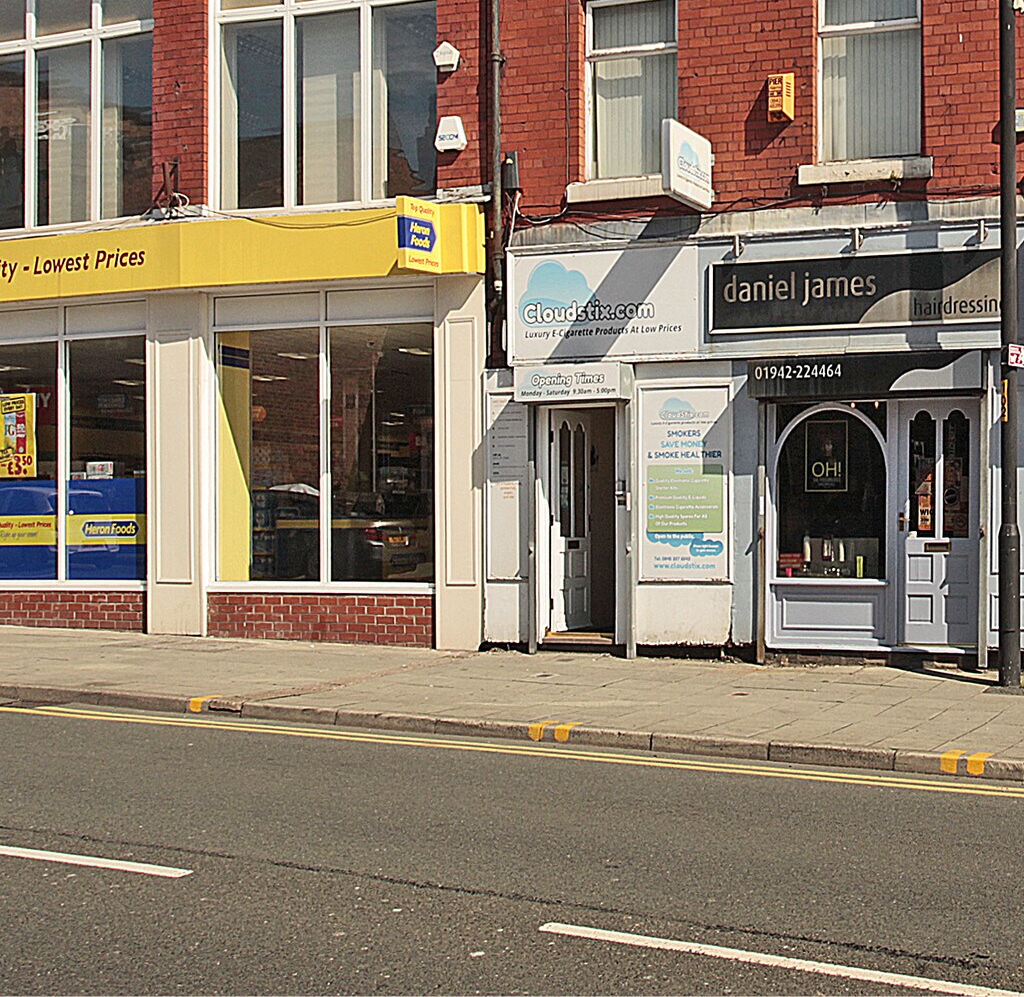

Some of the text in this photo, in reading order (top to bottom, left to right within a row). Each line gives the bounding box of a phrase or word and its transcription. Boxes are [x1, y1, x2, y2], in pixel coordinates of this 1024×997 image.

[410, 222, 431, 235] Heron
[410, 235, 431, 248] Foods
[0, 259, 17, 283] ty
[33, 253, 89, 275] Lowest
[95, 248, 145, 269] Prices
[723, 271, 877, 306] daniel james
[522, 300, 655, 324] Cloudstix.com
[913, 295, 1001, 316] hairdressin
[525, 330, 550, 339] Luxury
[552, 329, 594, 338] E-Cigarette
[595, 327, 629, 335] Products
[641, 325, 657, 333] Low
[658, 324, 682, 333] Prices
[754, 363, 842, 380] 01942-224464
[531, 371, 605, 388] Opening Times
[661, 440, 679, 448] SAVE
[681, 450, 722, 458] HEALTHIER
[812, 462, 841, 477] OH!
[84, 523, 136, 535] Heron Foods
